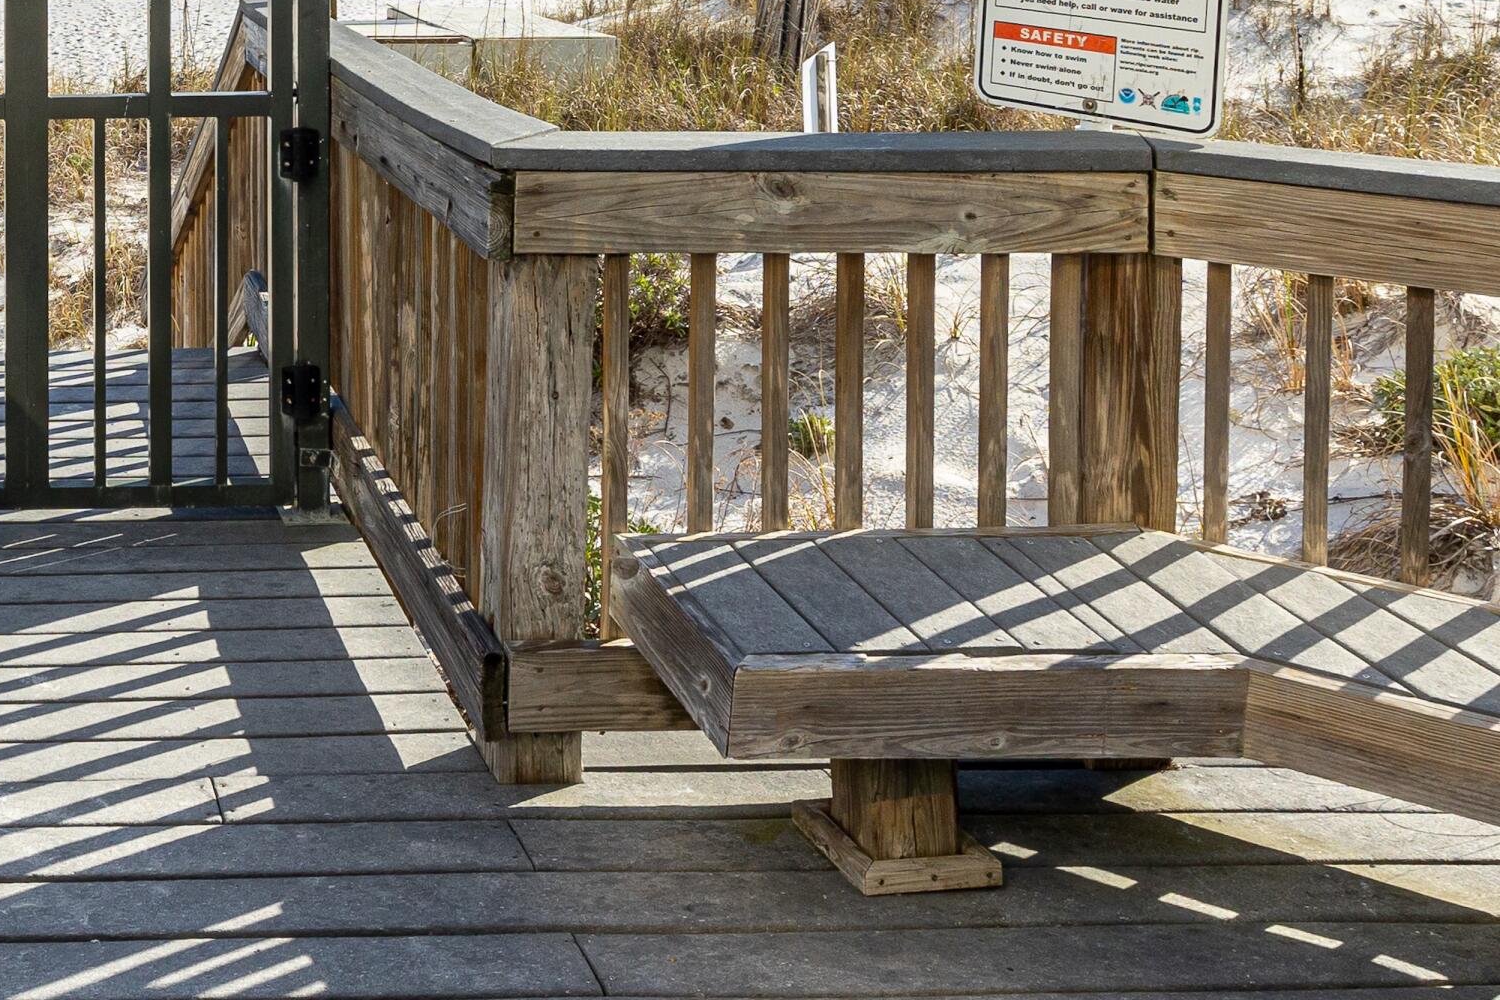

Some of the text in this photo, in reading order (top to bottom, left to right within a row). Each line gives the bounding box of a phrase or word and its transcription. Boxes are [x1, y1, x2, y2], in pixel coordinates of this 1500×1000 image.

[1059, 0, 1079, 9] help,
[1110, 7, 1132, 15] wave
[1135, 9, 1147, 17] for
[1149, 12, 1198, 23] assistance
[1020, 28, 1087, 47] SAFETY
[1011, 46, 1034, 55] Know
[1035, 50, 1052, 58] how
[1065, 55, 1087, 63] swim
[1010, 59, 1033, 67] Never
[1059, 67, 1082, 75] alone
[1027, 74, 1053, 85] doubt,
[1055, 79, 1075, 87] don't
